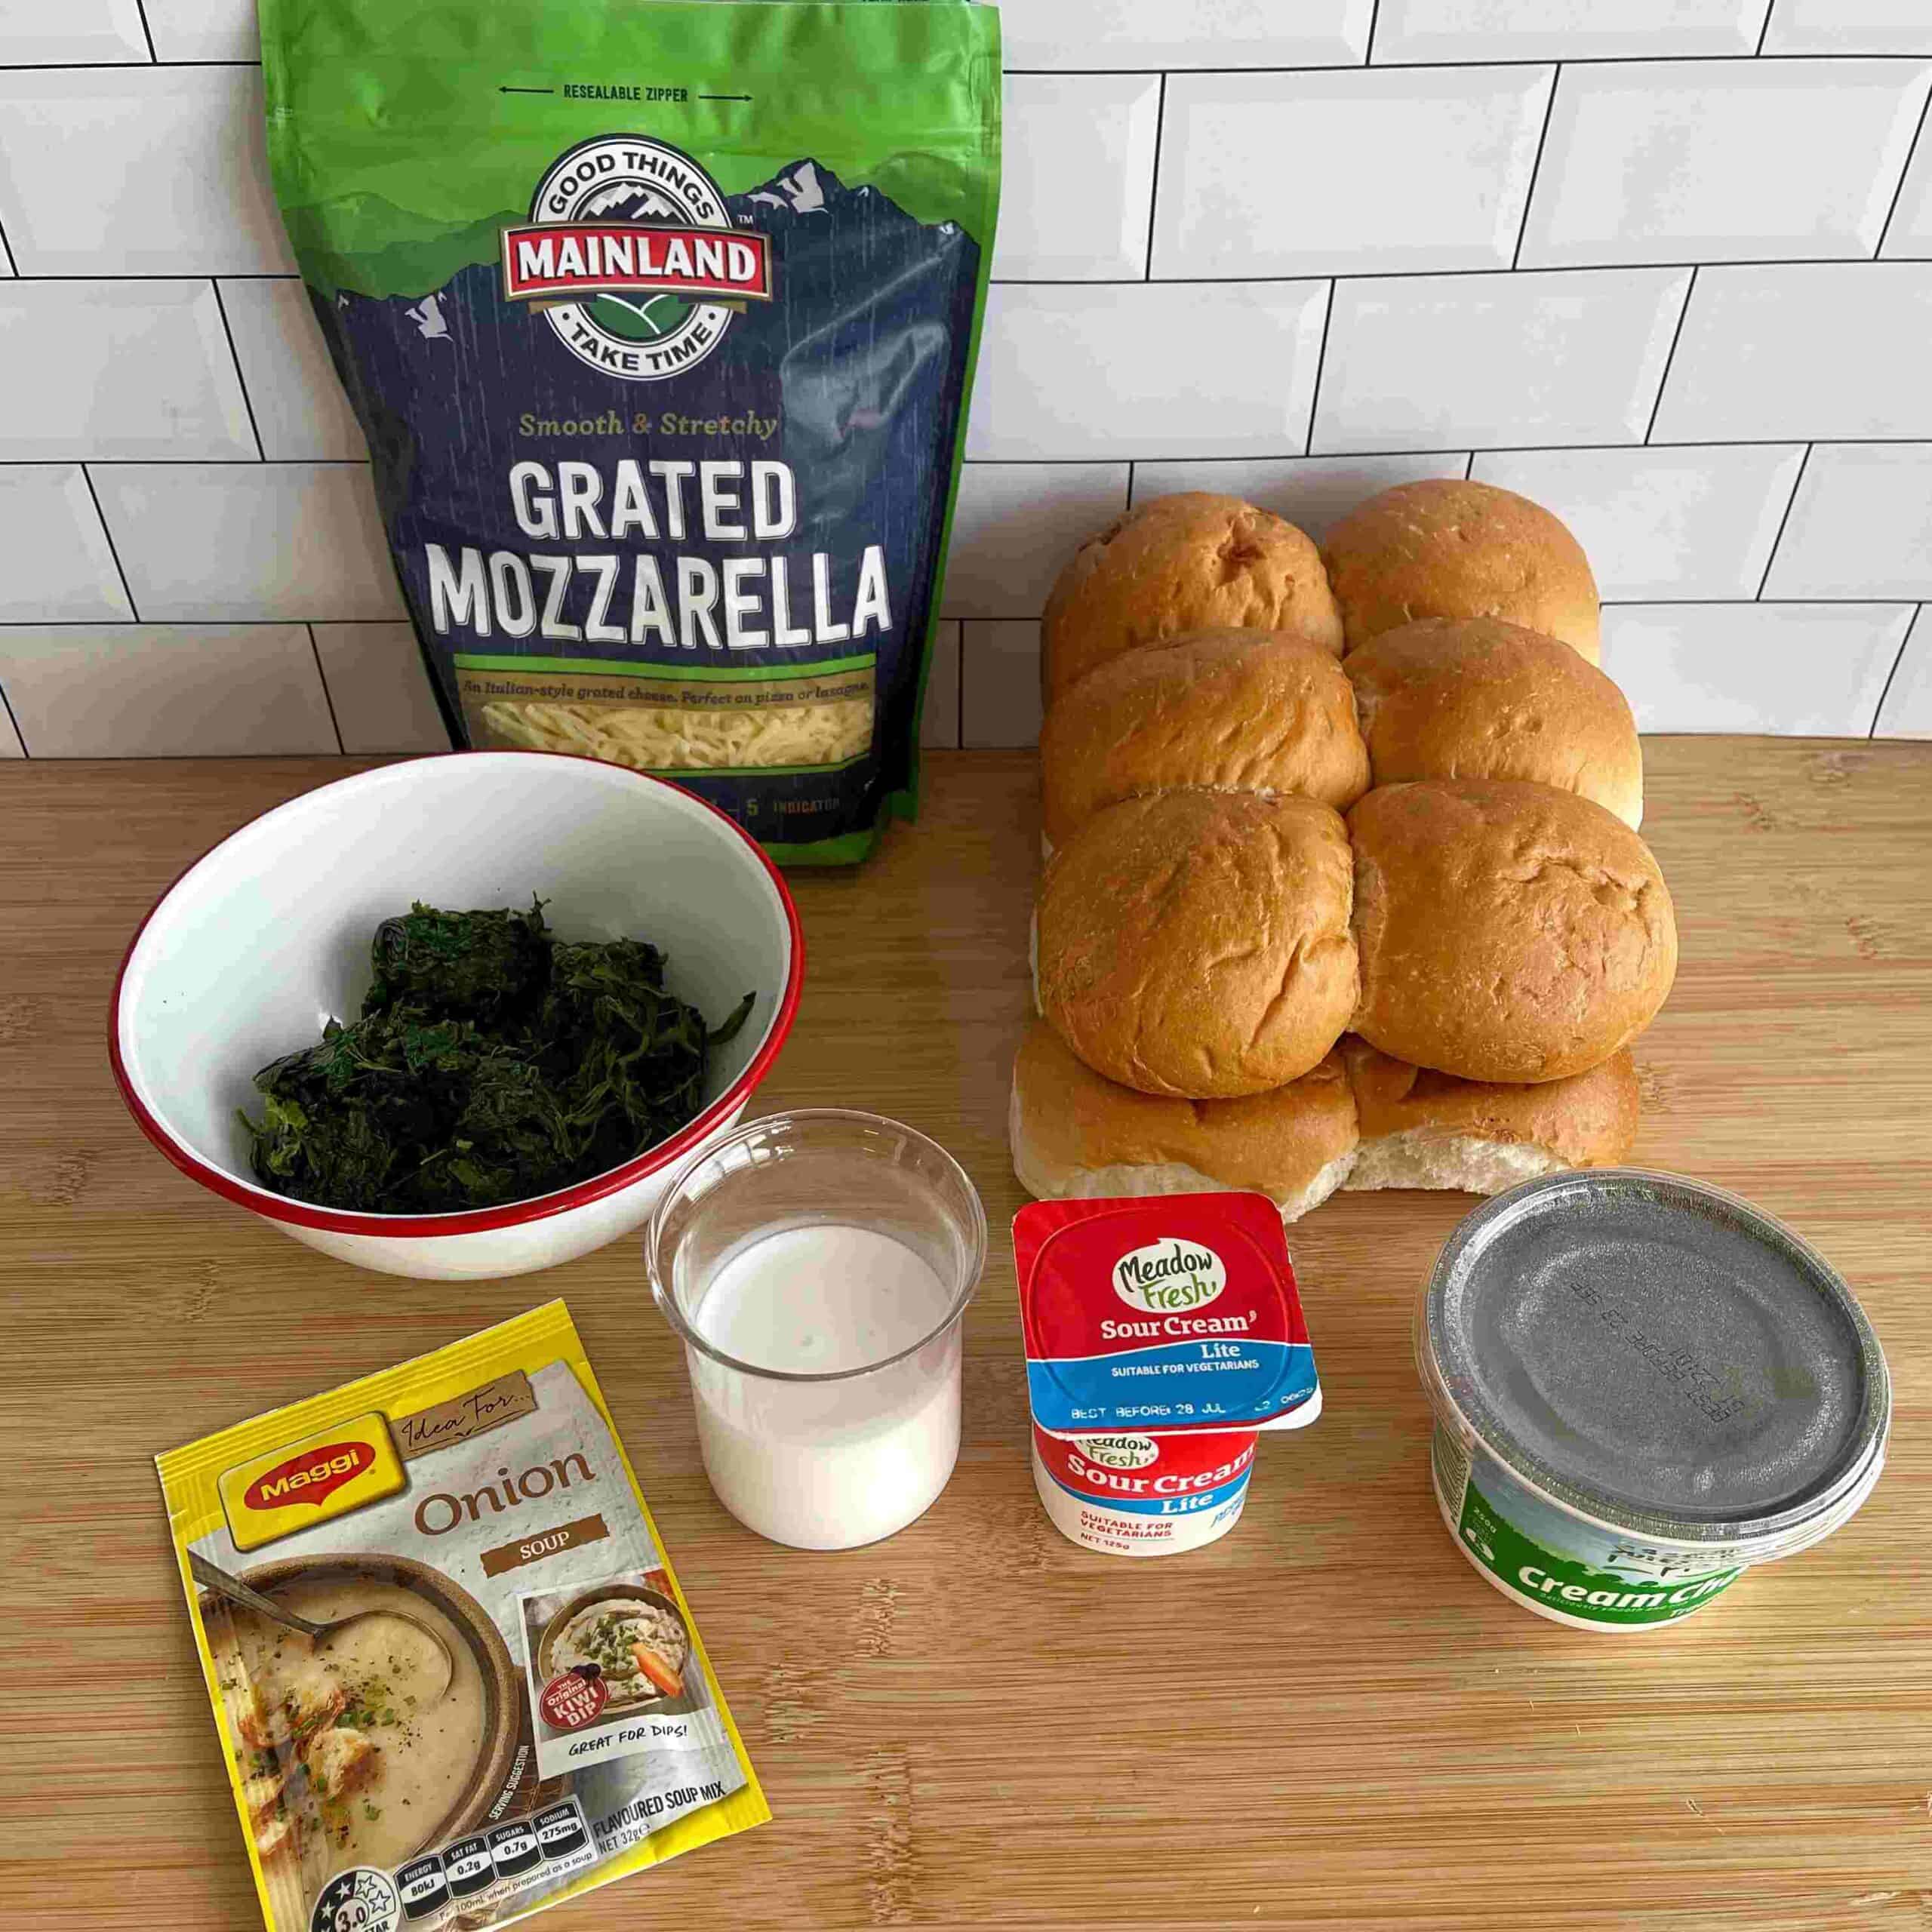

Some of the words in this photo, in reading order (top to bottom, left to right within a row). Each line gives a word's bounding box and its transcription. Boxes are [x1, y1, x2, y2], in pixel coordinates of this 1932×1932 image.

[564, 84, 641, 101] RESEALABLE
[646, 88, 688, 103] ZIPPER
[548, 152, 615, 214] GOOD
[622, 151, 715, 221] THINGS
[517, 235, 756, 282] MAINLAND
[570, 320, 641, 371] TAKE
[646, 322, 713, 371] TIME
[518, 414, 625, 437] Smooth
[632, 414, 652, 435] &
[660, 413, 778, 441] Stretchy
[508, 458, 797, 541] GRATED
[424, 543, 894, 651] MOZZARELLA
[485, 681, 574, 700] Italian-style
[577, 686, 624, 700] grated
[681, 690, 732, 705] Perfect
[756, 693, 793, 706] pizza
[798, 691, 812, 700] or
[1118, 1244, 1212, 1293] Meadow
[1138, 1273, 1211, 1309] Fresh
[1100, 1319, 1161, 1340] Sour
[1164, 1315, 1250, 1336] Cream
[1201, 1343, 1241, 1358] Lite
[1112, 1366, 1161, 1377] SUITABLE
[1162, 1363, 1185, 1374] FOR
[1186, 1359, 1260, 1373] VEGETARIANS
[1072, 1407, 1107, 1420] BEST
[1175, 1403, 1195, 1416] 28
[1201, 1402, 1226, 1415] JUL
[401, 1416, 466, 1447] Idea
[1078, 1436, 1152, 1451] eadow
[1089, 1446, 1142, 1467] Fresh
[260, 1449, 360, 1502] Maggi
[1067, 1454, 1149, 1493] Sour
[414, 1452, 596, 1536] Onion
[1161, 1494, 1214, 1514] Lite
[1081, 1510, 1143, 1529] SUITABLE
[1081, 1518, 1172, 1537] VEGETARIANS
[519, 1531, 571, 1560] SOUP
[1080, 1532, 1102, 1544] NET
[1103, 1537, 1130, 1550] 125g
[1518, 1566, 1666, 1607] Cream
[547, 1678, 586, 1706] Original
[553, 1687, 598, 1719] KIWI
[567, 1702, 596, 1726] DIP
[568, 1735, 614, 1757] GREAT
[618, 1727, 646, 1743] FOR
[651, 1724, 688, 1738] DIPS!
[489, 1789, 514, 1820] SERVING
[506, 1745, 530, 1791] SUGGESTION
[539, 1808, 570, 1826] SODIUM
[593, 1799, 664, 1838] FLAVOURED
[665, 1789, 699, 1810] SOUP
[699, 1781, 727, 1799] MIX
[495, 1826, 525, 1842] SUGARS
[542, 1823, 578, 1841] 275mg
[451, 1847, 464, 1861] SAT
[464, 1842, 478, 1855] FAT
[503, 1841, 528, 1856] 0.7g
[597, 1840, 619, 1854] NET
[404, 1862, 434, 1882] ENERGY
[457, 1860, 481, 1875] 0.2g
[488, 1886, 511, 1901] when
[512, 1866, 551, 1890] prepared
[552, 1863, 563, 1873] as
[571, 1852, 592, 1866] soup
[410, 1878, 435, 1897] 80kJ
[338, 1906, 366, 1932] 3.0
